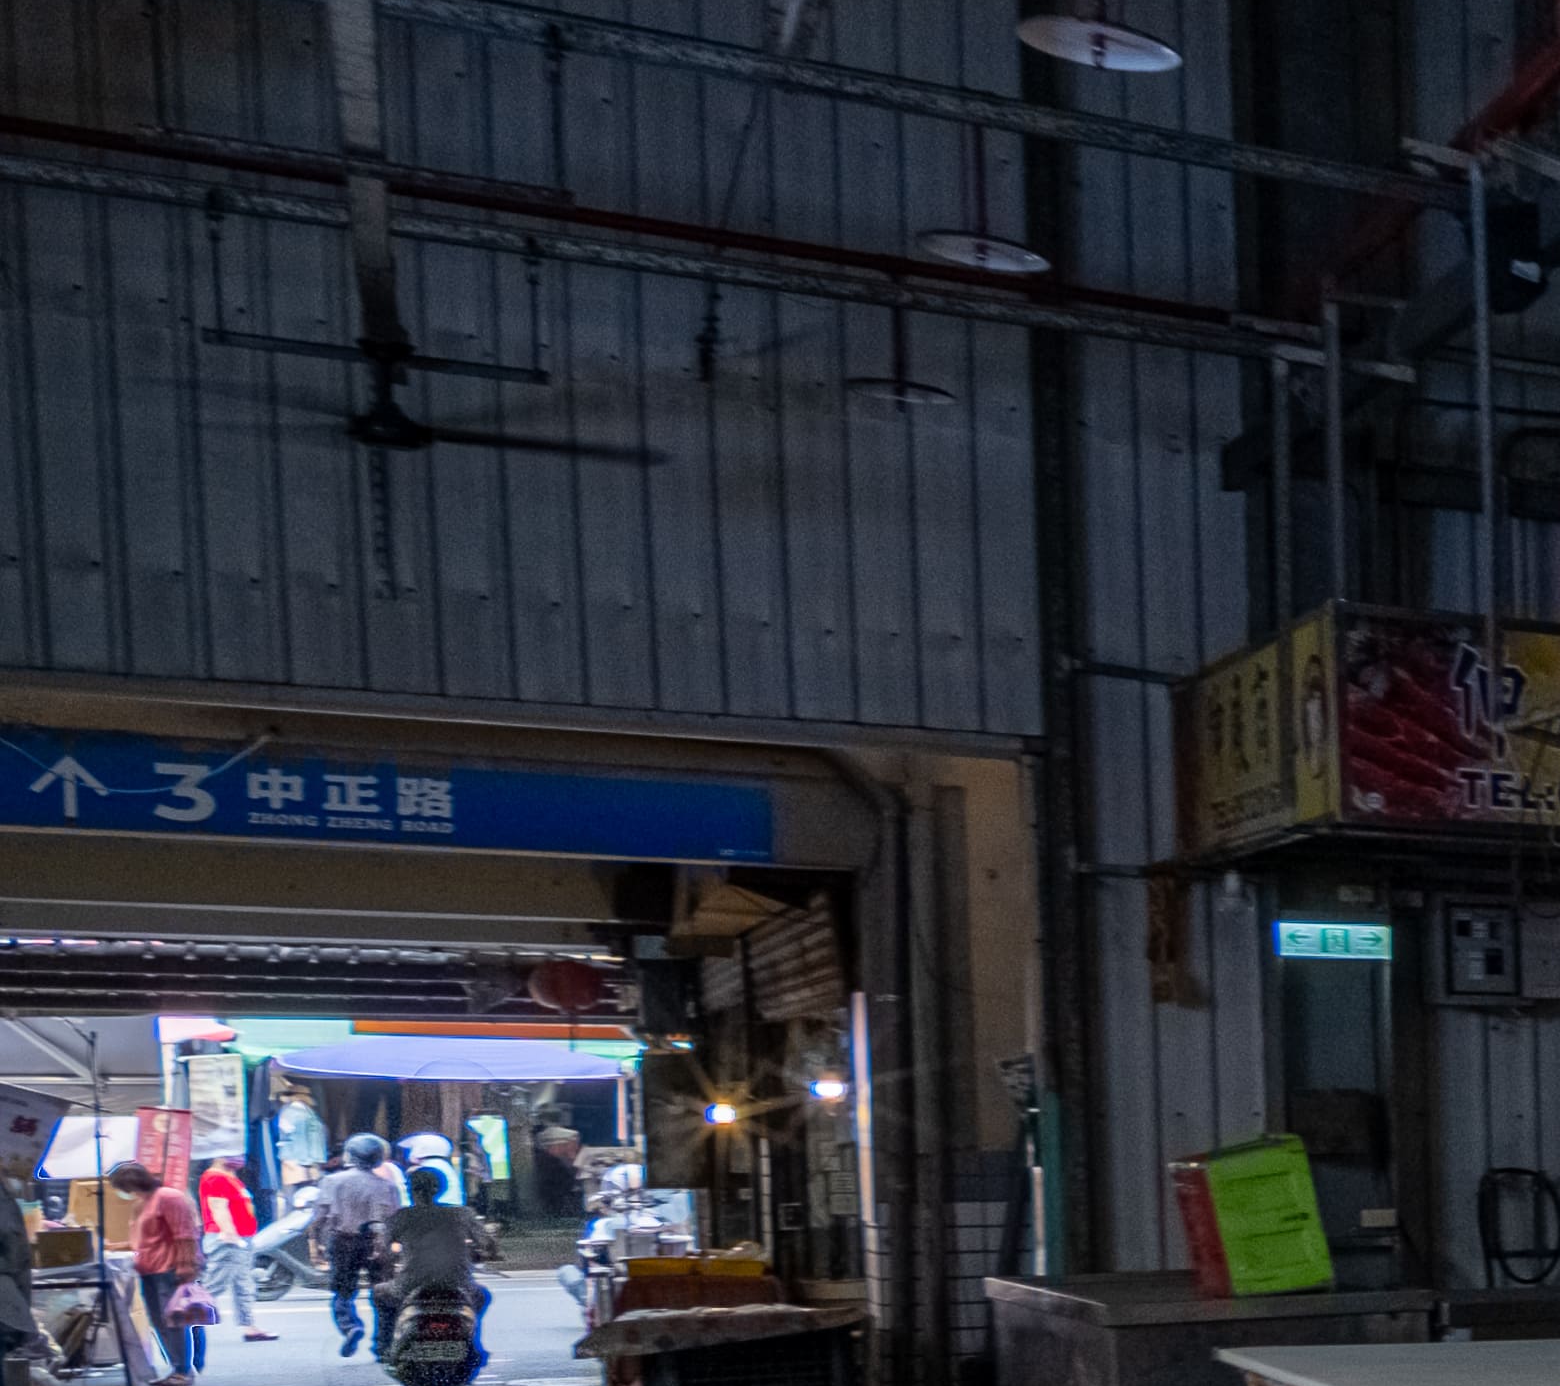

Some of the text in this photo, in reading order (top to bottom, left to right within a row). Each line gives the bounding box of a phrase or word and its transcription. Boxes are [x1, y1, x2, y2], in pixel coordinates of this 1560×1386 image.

[153, 762, 217, 822] 3
[247, 768, 452, 818] 中正路
[248, 812, 454, 834] ZHONG ZHENG ROAD
